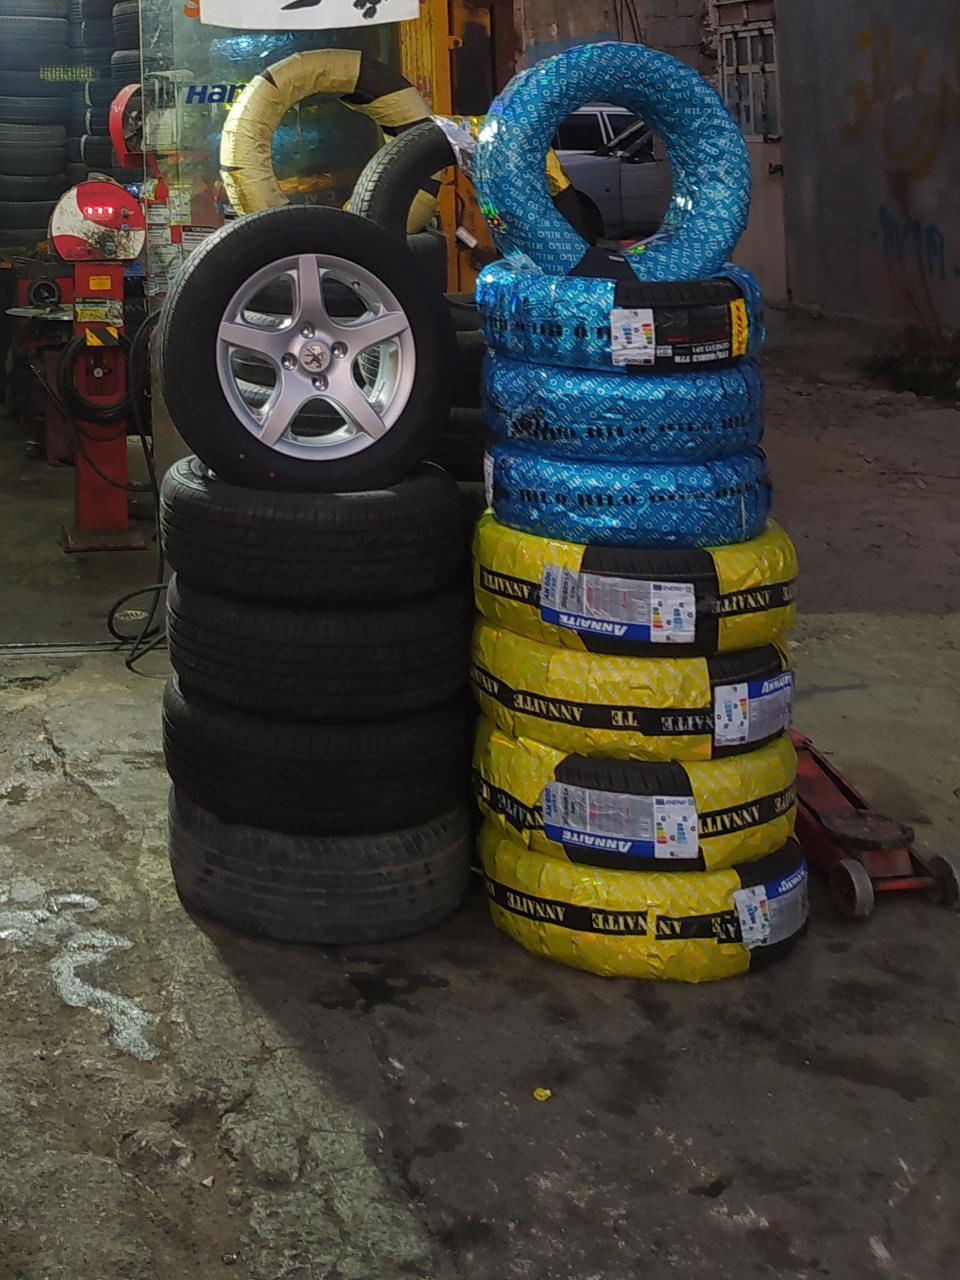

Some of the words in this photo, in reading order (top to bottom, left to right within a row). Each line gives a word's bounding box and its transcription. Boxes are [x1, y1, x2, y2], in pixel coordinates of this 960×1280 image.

[558, 614, 628, 636] ANNAITE
[513, 693, 584, 722] ANNAITE
[563, 830, 633, 853] ANNAITE
[507, 892, 566, 921] ANNAITE
